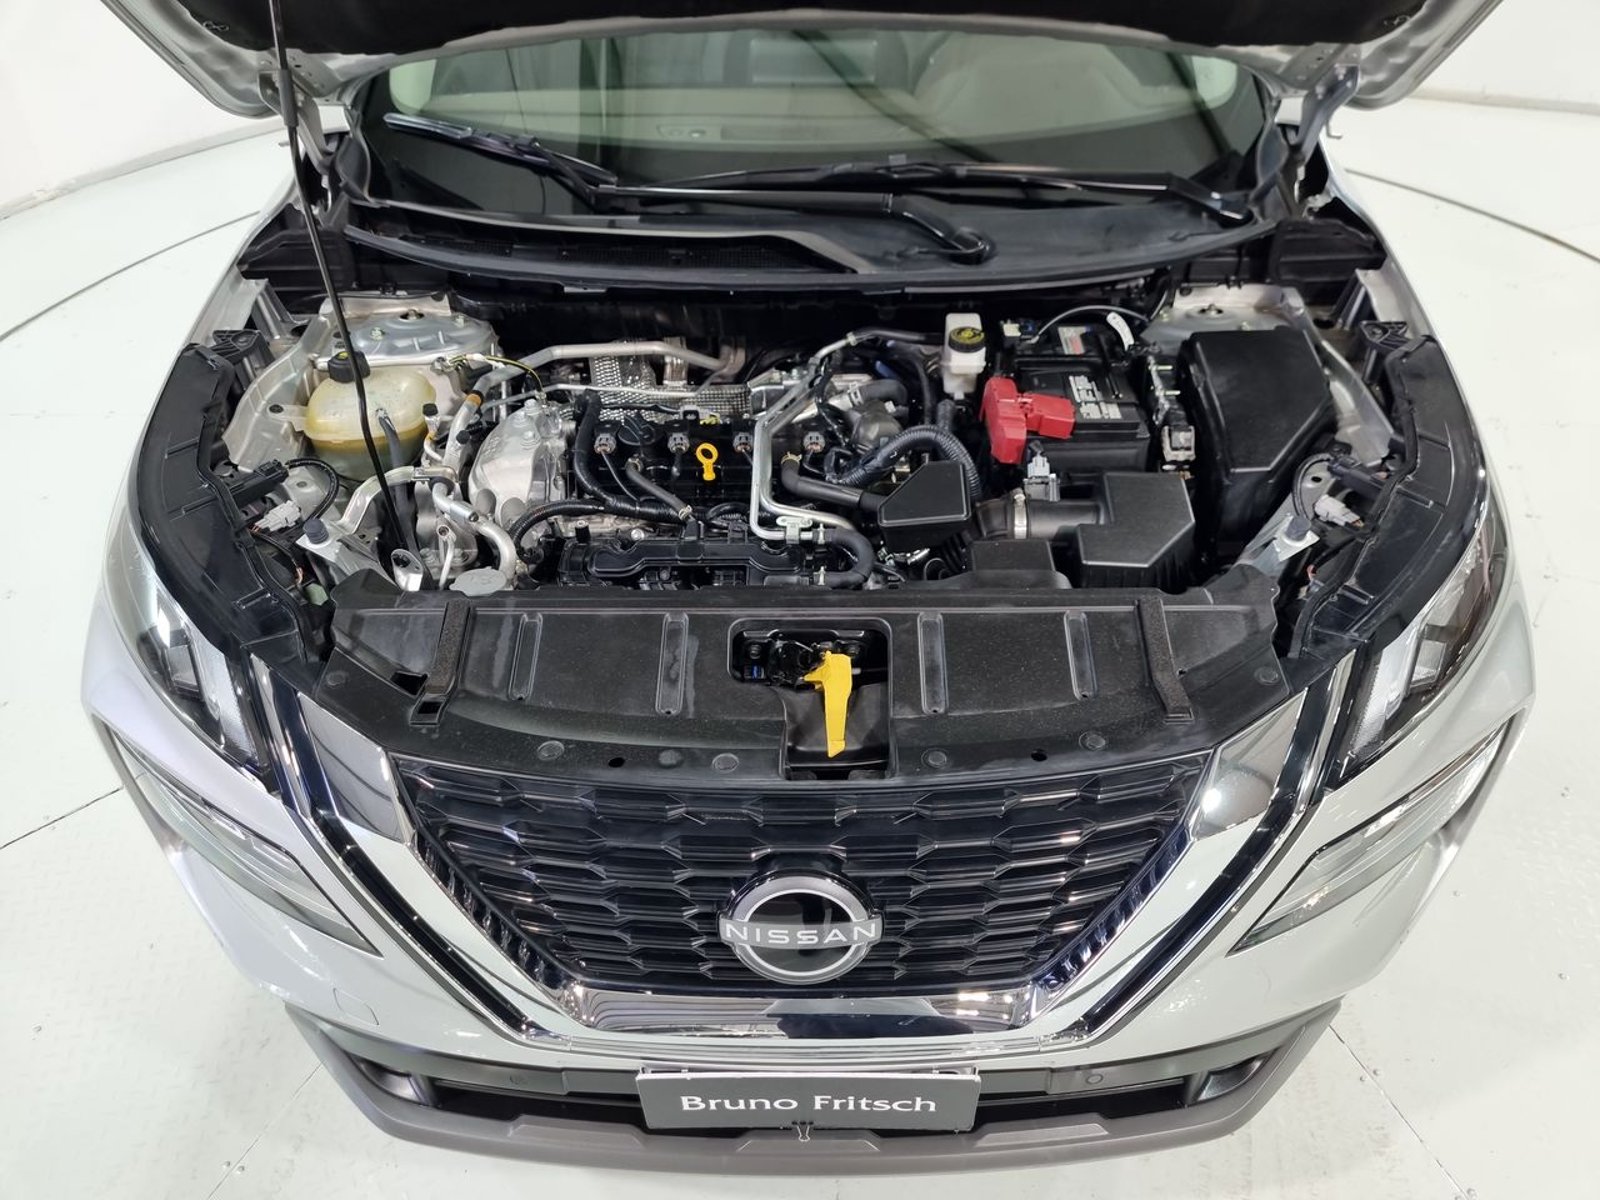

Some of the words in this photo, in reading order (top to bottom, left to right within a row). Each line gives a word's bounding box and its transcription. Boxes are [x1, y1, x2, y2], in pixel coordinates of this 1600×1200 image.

[725, 923, 876, 945] NISSAN
[680, 1095, 799, 1111] Bruno
[813, 1095, 937, 1112] Fritsch
